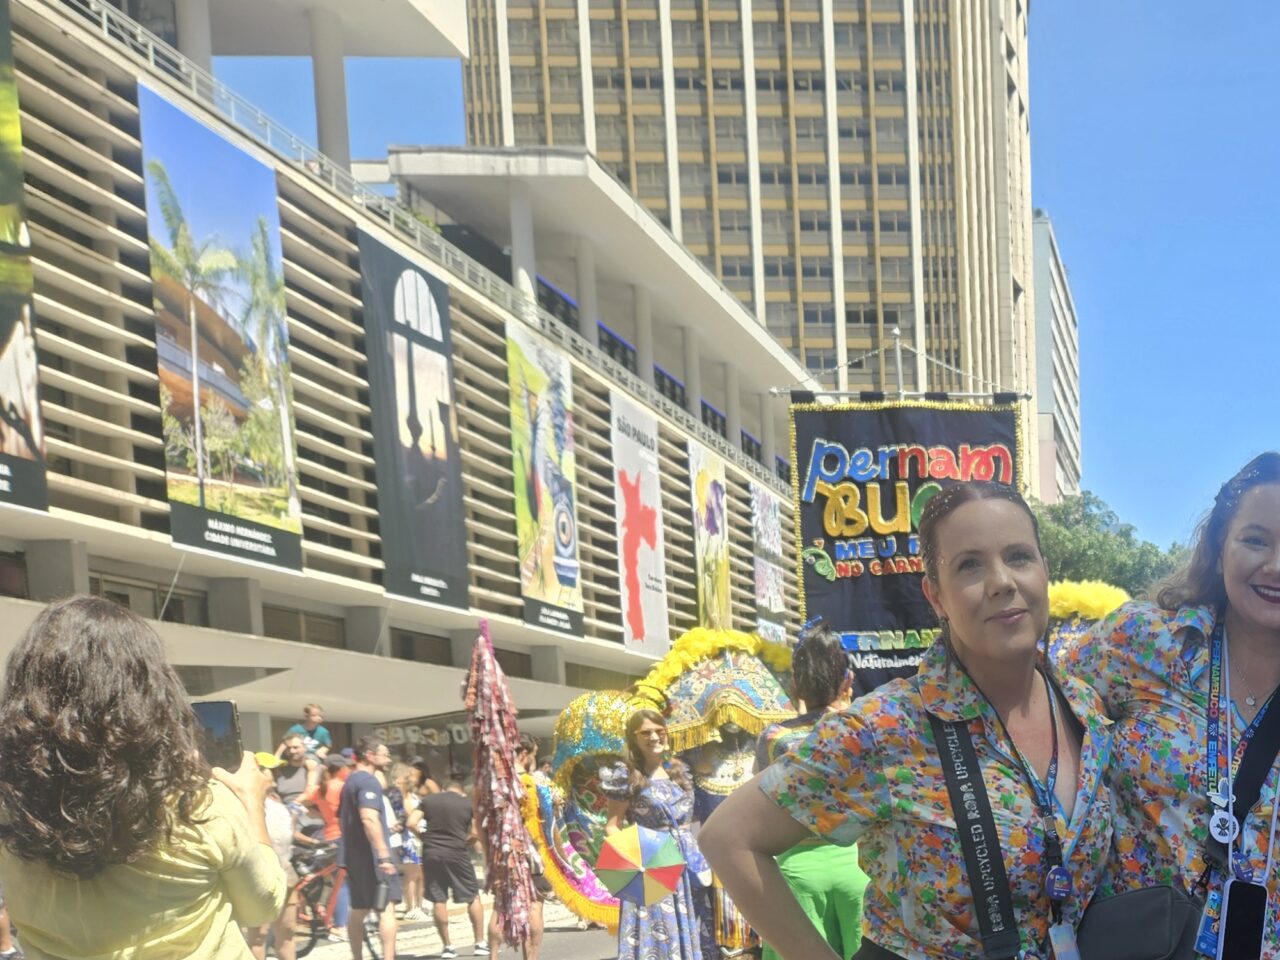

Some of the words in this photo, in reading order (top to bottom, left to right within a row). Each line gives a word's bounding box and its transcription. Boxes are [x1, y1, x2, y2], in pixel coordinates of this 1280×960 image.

[816, 481, 943, 538] BUC
[834, 536, 898, 560] MEU
[836, 560, 864, 578] NO
[868, 556, 925, 576] CARN
[848, 652, 924, 670] Naturalmen
[943, 724, 969, 780] UPCYCLE
[1208, 740, 1218, 793] EMPETU
